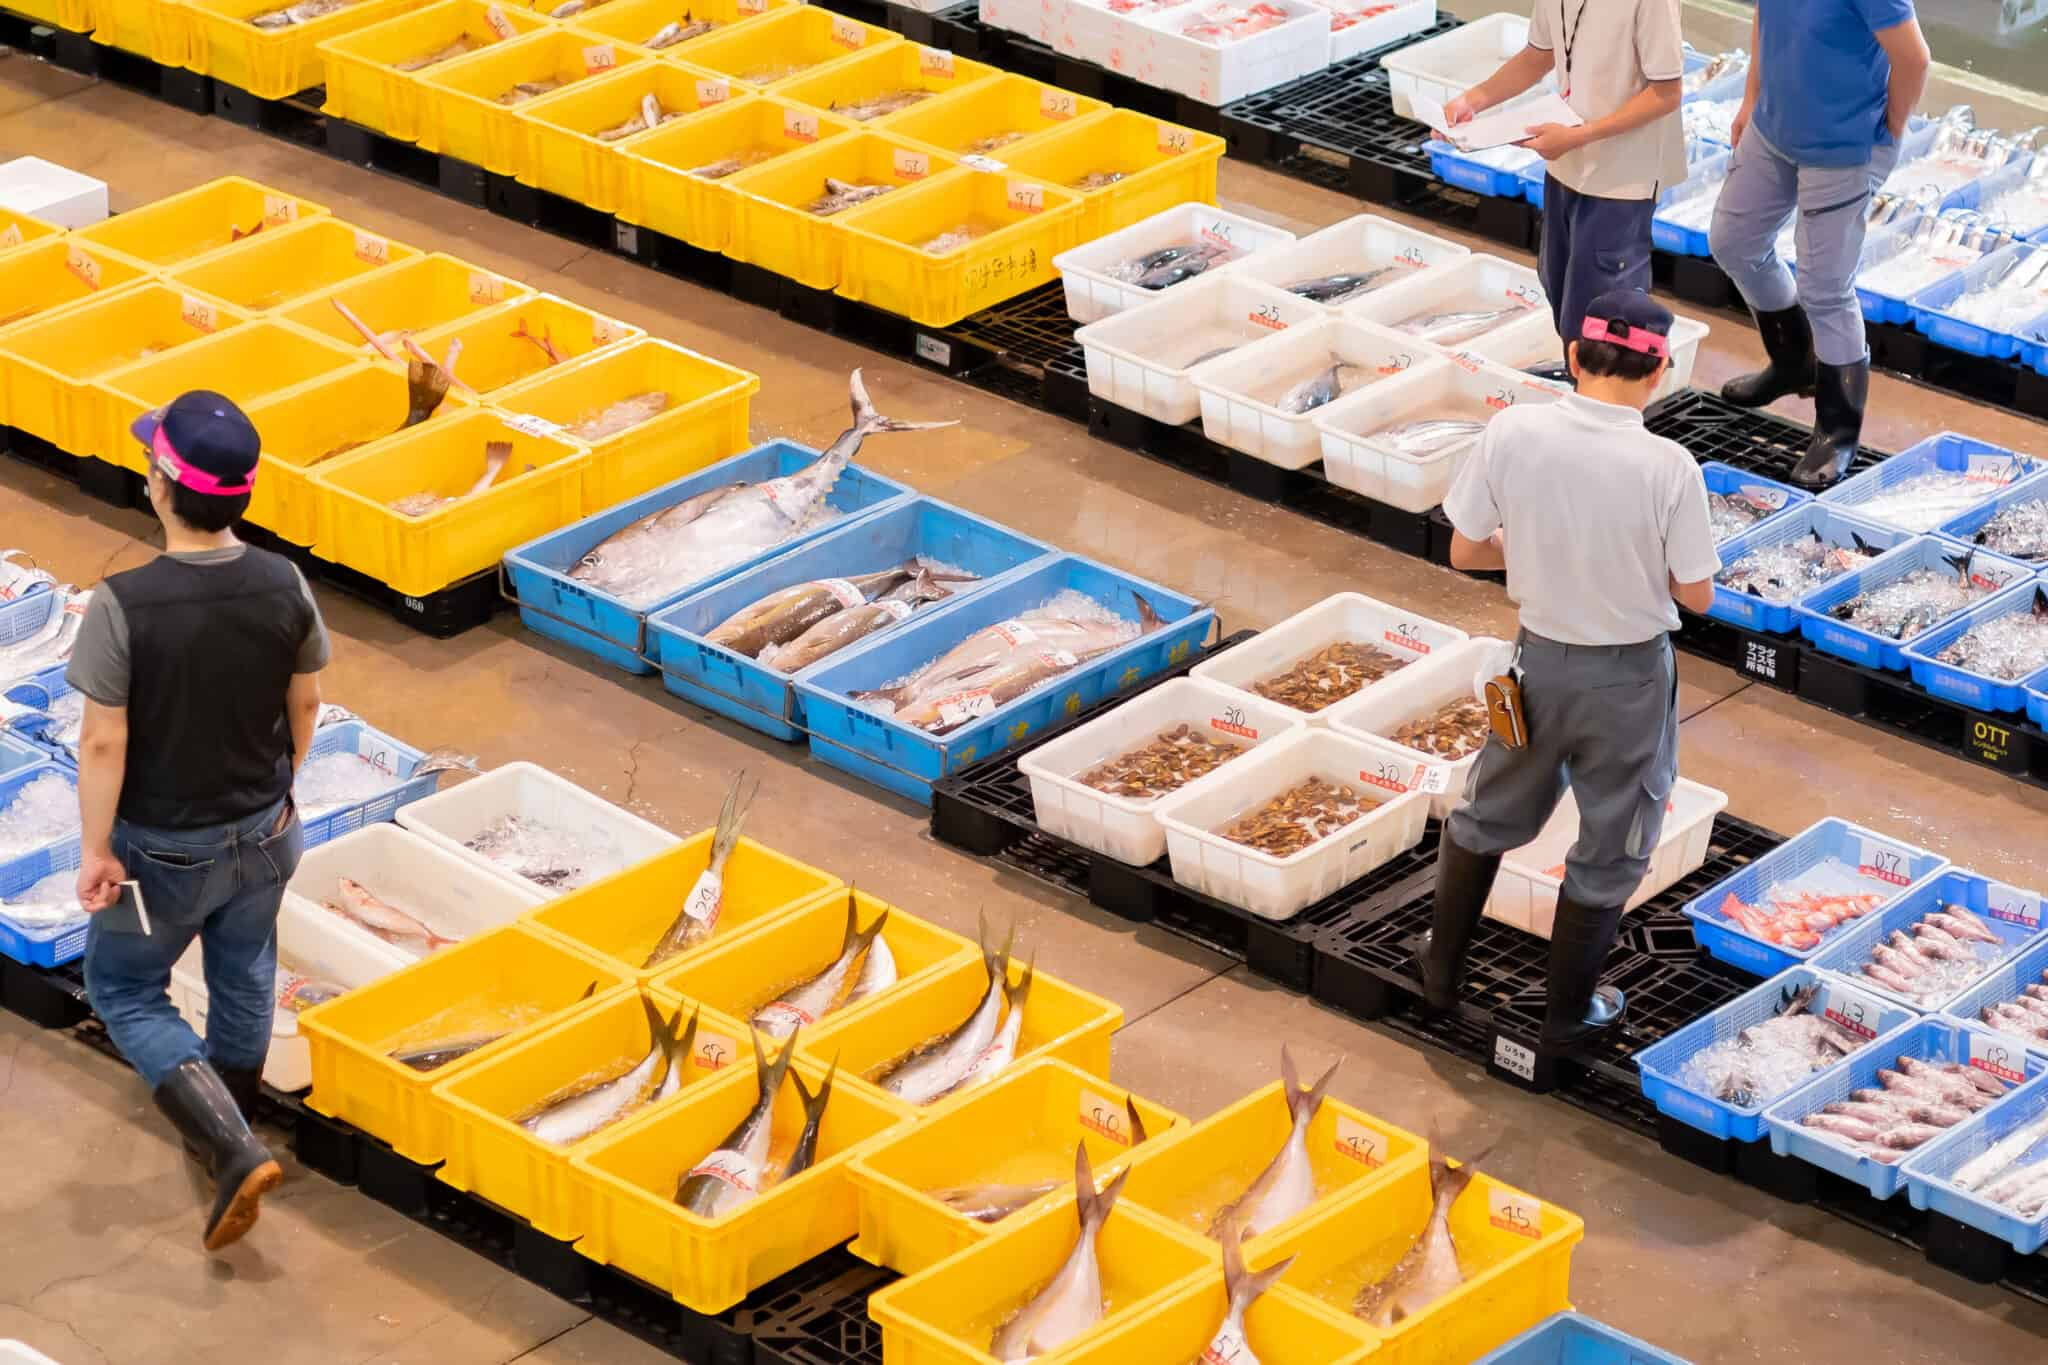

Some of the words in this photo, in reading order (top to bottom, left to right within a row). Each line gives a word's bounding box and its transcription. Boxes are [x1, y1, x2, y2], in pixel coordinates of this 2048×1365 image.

[1747, 641, 1776, 657] サラダ
[1746, 651, 1776, 668] コスモ
[1975, 722, 2010, 747] OTT
